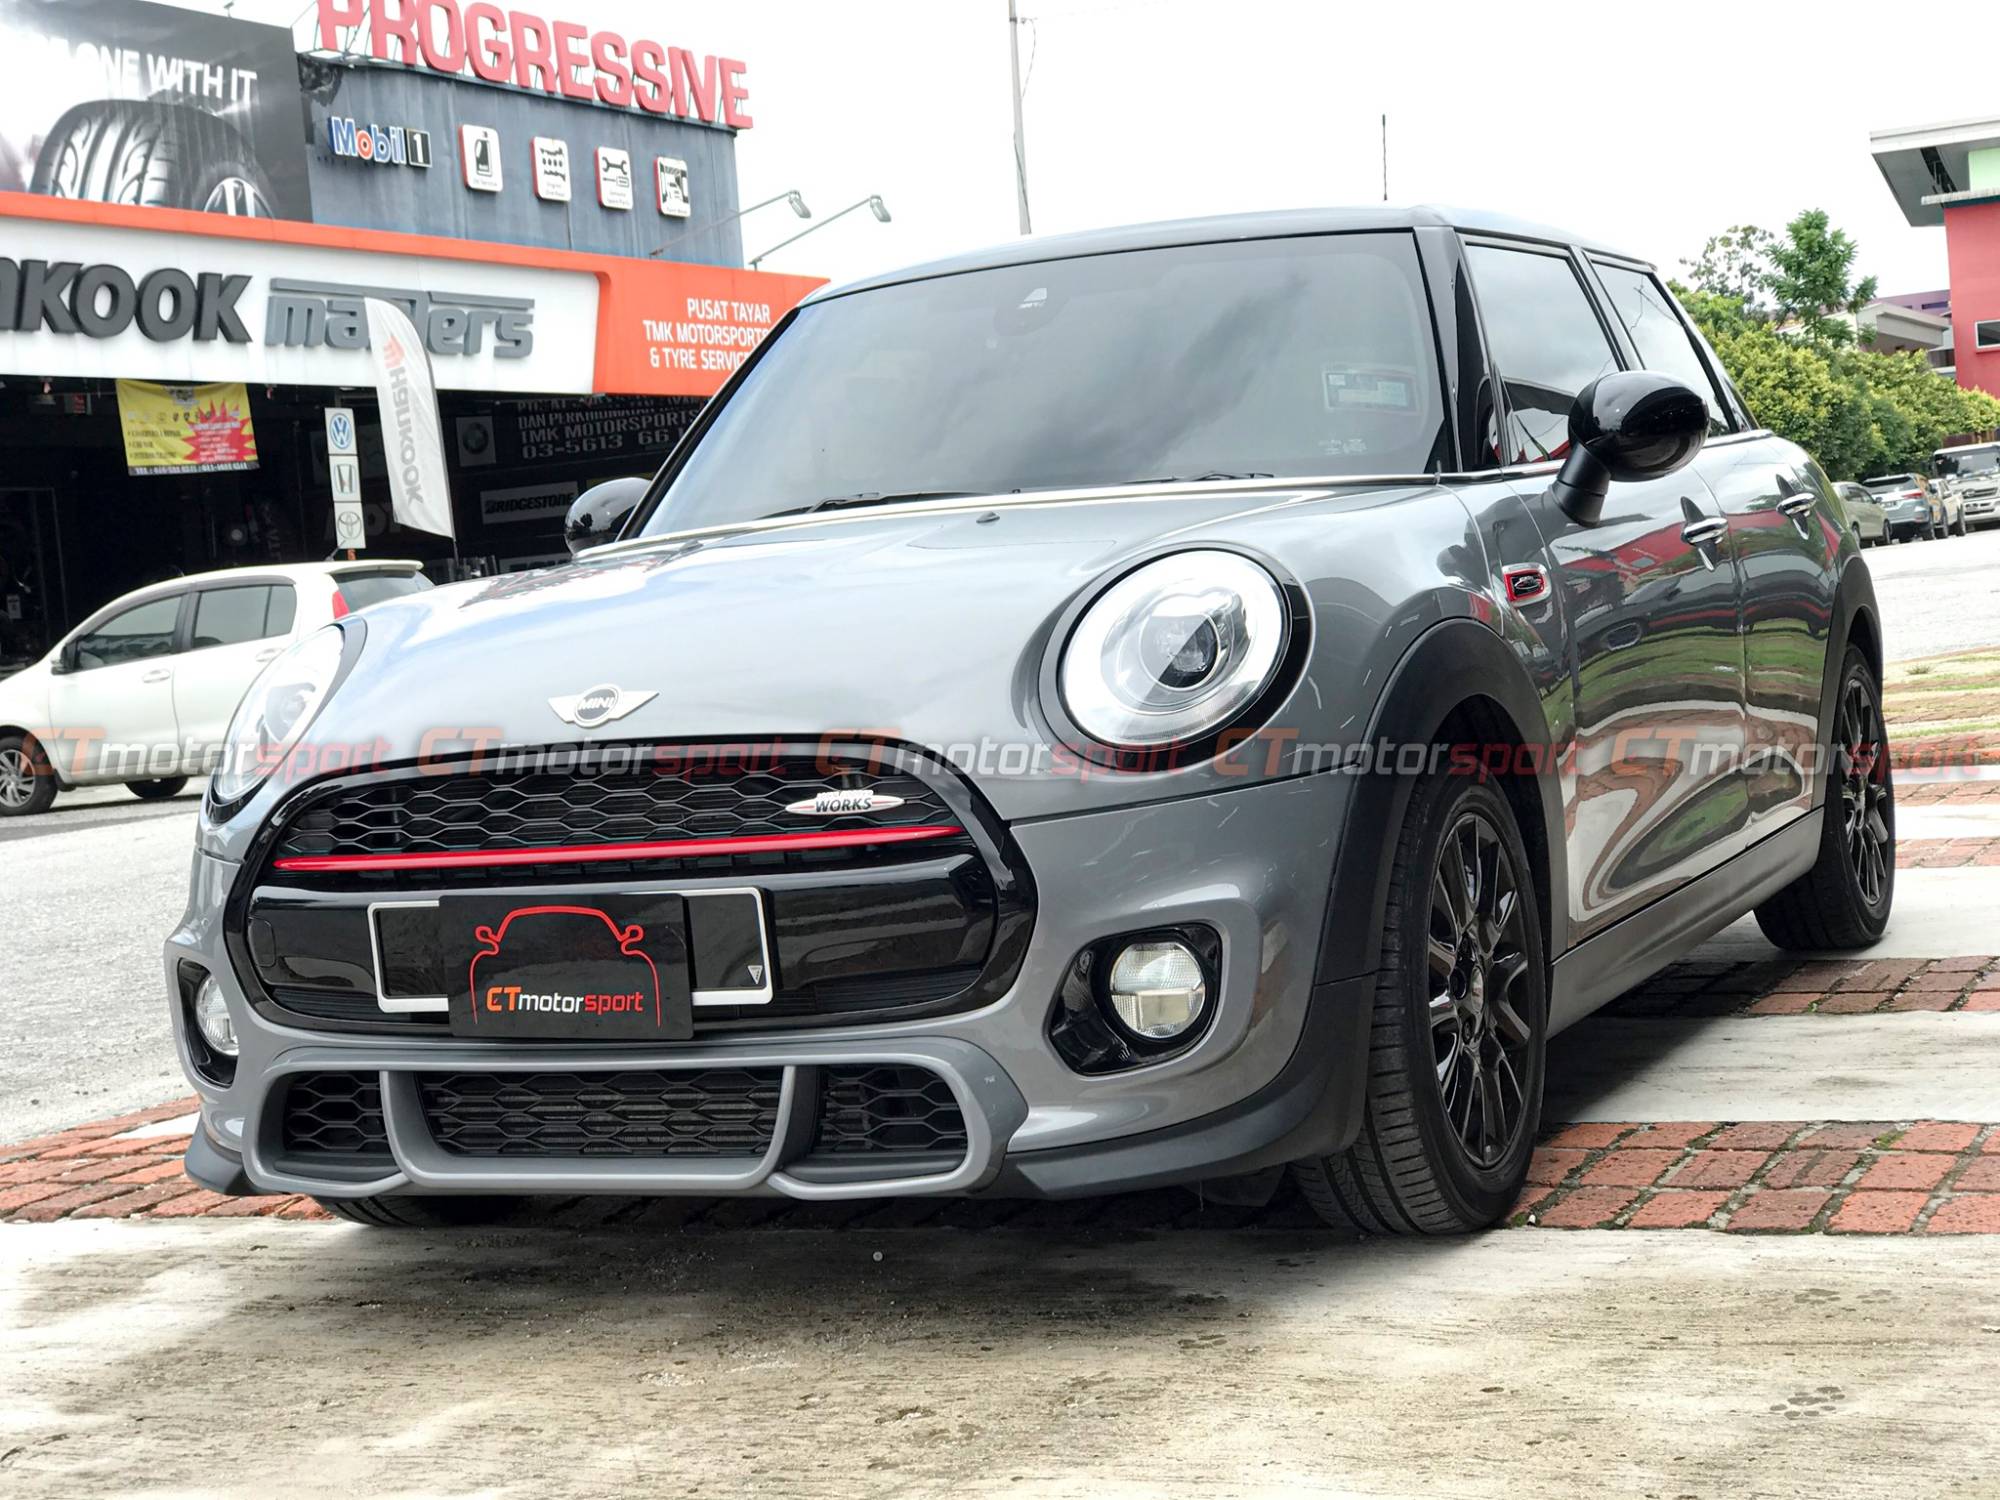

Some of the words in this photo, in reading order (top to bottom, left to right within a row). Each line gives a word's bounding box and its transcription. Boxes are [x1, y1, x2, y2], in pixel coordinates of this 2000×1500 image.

[318, 0, 753, 129] PROGRESSIVE
[147, 54, 223, 99] WITH
[231, 68, 258, 105] IT
[328, 116, 407, 165] Mobil
[687, 298, 728, 321] PUSAT
[731, 302, 771, 324] TAYAR
[642, 320, 674, 343] TMK
[650, 347, 660, 369] &
[662, 347, 697, 370] TYRE
[578, 696, 615, 710] MINI
[815, 797, 872, 813] WORKS
[486, 986, 644, 1016] CTmotorsport
